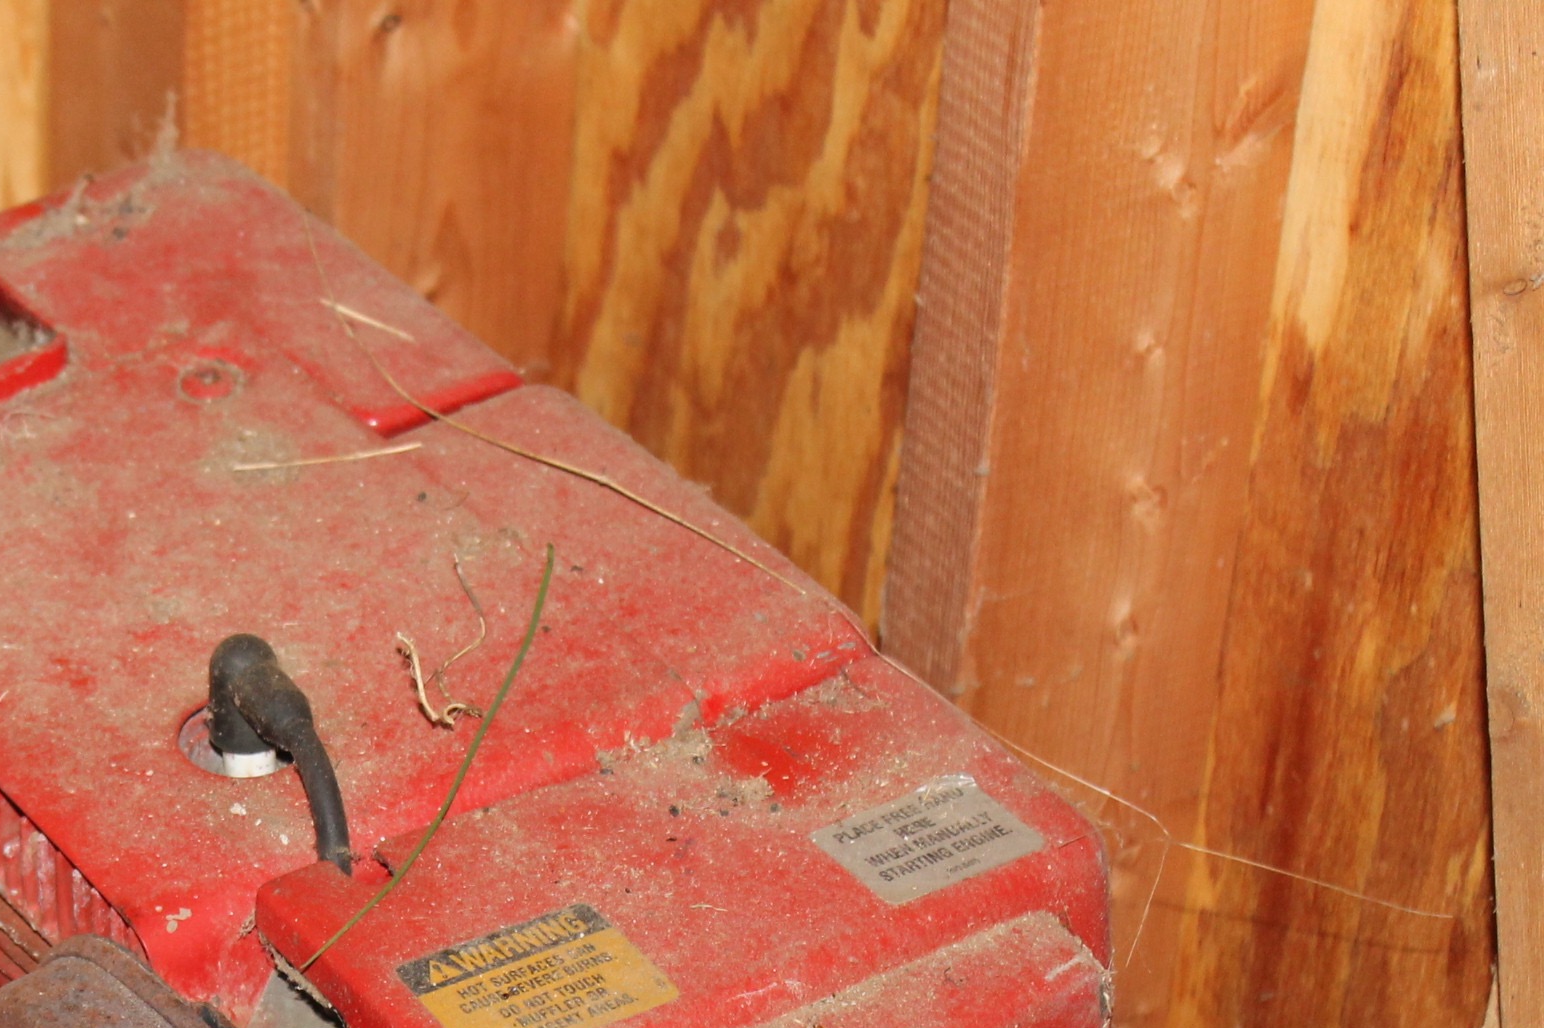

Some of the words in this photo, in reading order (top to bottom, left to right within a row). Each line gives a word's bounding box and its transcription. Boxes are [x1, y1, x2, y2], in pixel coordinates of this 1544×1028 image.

[832, 819, 884, 844] PLACE
[882, 804, 922, 825] FREE
[864, 843, 912, 867] WHEN
[913, 811, 993, 850] MANUALLY
[893, 818, 936, 839] HERE
[878, 847, 954, 882] STARTING
[951, 824, 1014, 852] ENGINE.
[449, 913, 587, 971] WARNING
[457, 981, 487, 1000] HOT
[490, 954, 566, 988] SURFACES
[499, 1003, 521, 1019] DO
[523, 991, 555, 1010] NOT
[556, 972, 606, 998] TOUCH
[459, 989, 506, 1014] CAUSE
[516, 997, 582, 1028] MUFFLER
[585, 987, 608, 1003] OR
